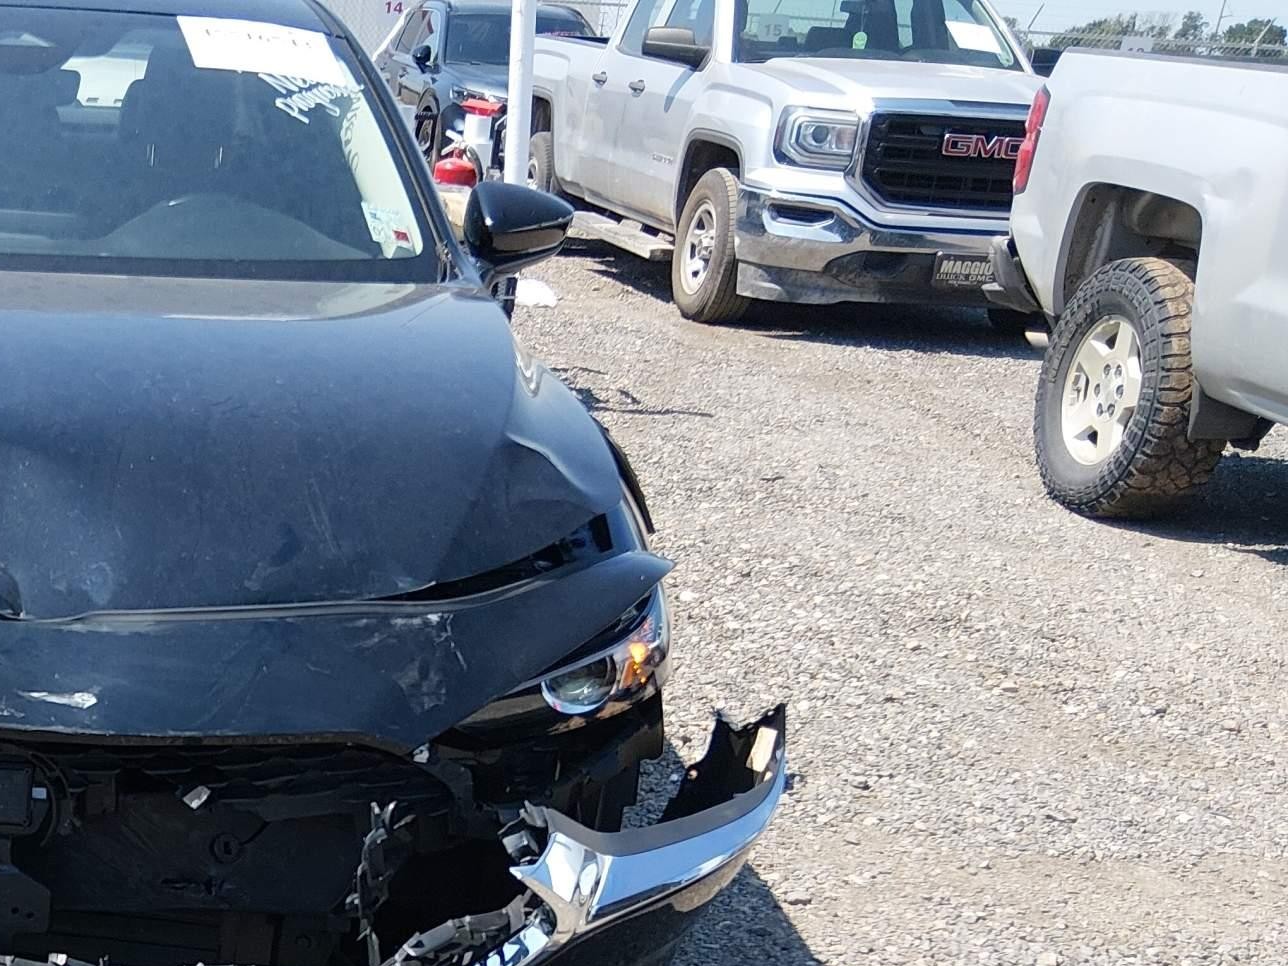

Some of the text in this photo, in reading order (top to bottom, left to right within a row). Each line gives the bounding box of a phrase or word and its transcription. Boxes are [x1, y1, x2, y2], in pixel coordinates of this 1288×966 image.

[385, 1, 403, 14] 14
[942, 133, 1025, 160] GMC
[968, 274, 994, 282] GMC
